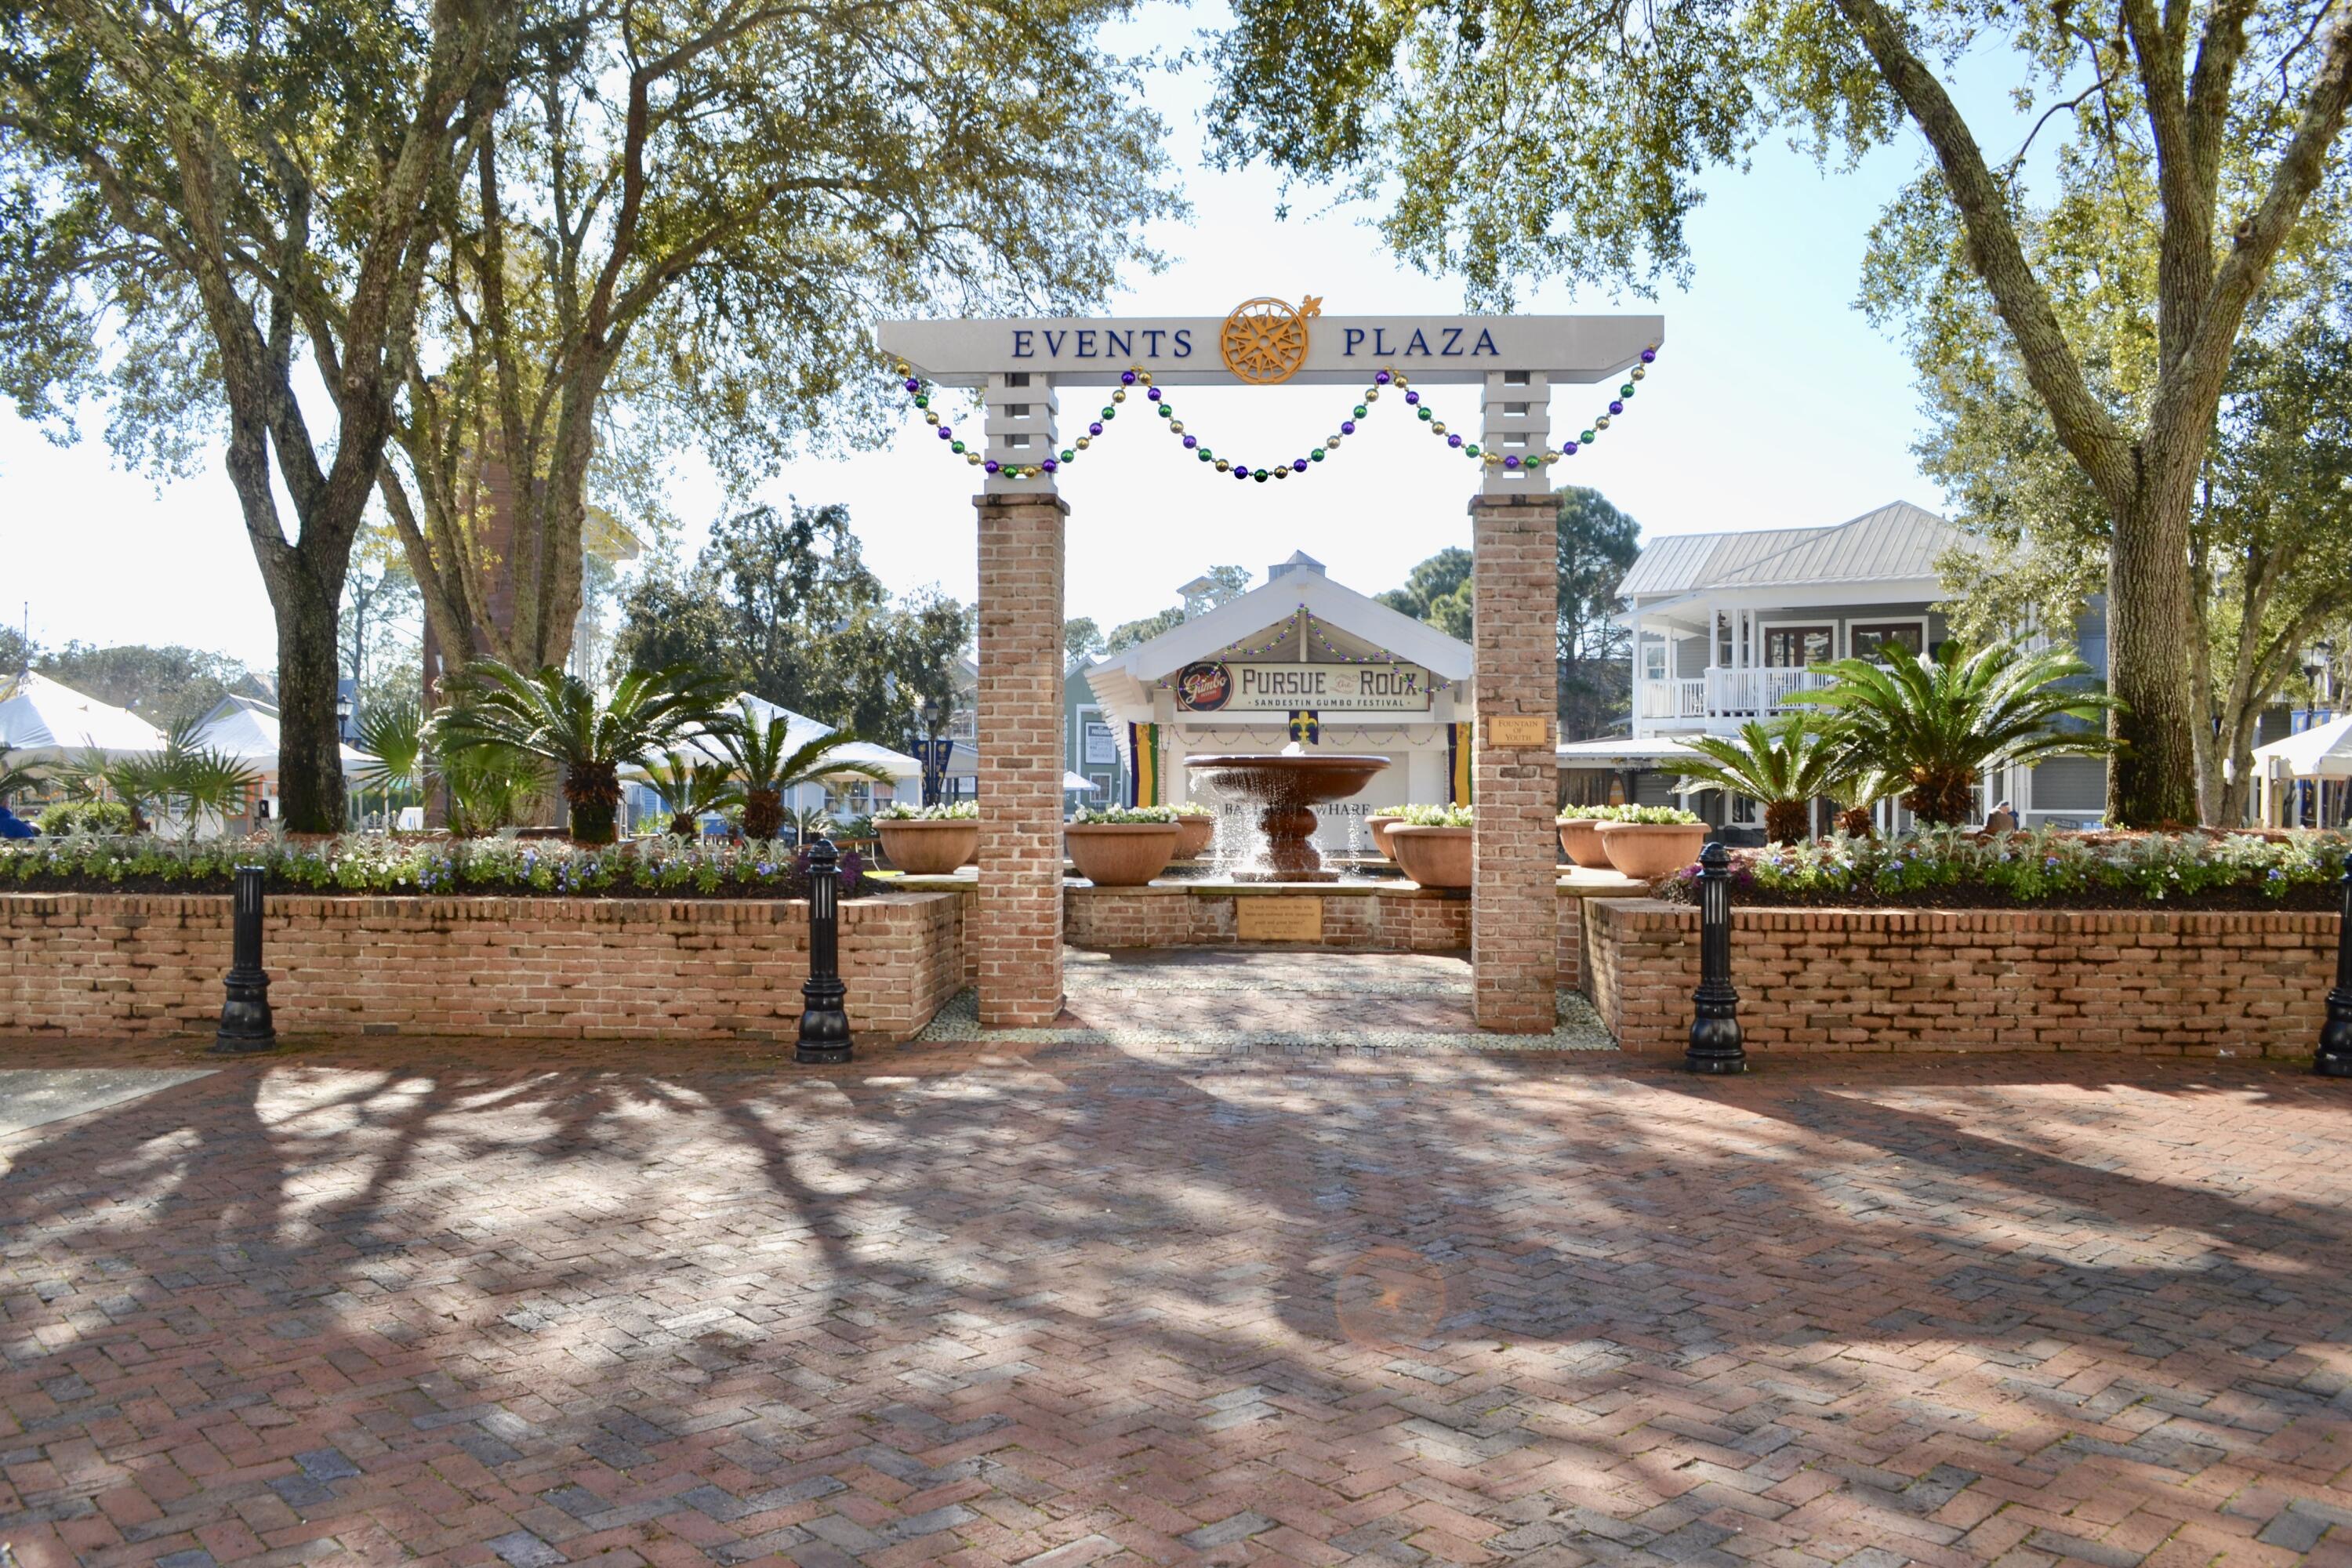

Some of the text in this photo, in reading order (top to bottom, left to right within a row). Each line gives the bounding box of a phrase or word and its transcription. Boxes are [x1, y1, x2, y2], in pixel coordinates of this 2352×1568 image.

[1011, 328, 1500, 358] EVENTS PLAZA
[1183, 671, 1228, 704] Gumbo
[1242, 669, 1327, 695] PURSUE
[1359, 670, 1417, 695] ROUX
[1316, 804, 1371, 815] WHARF
